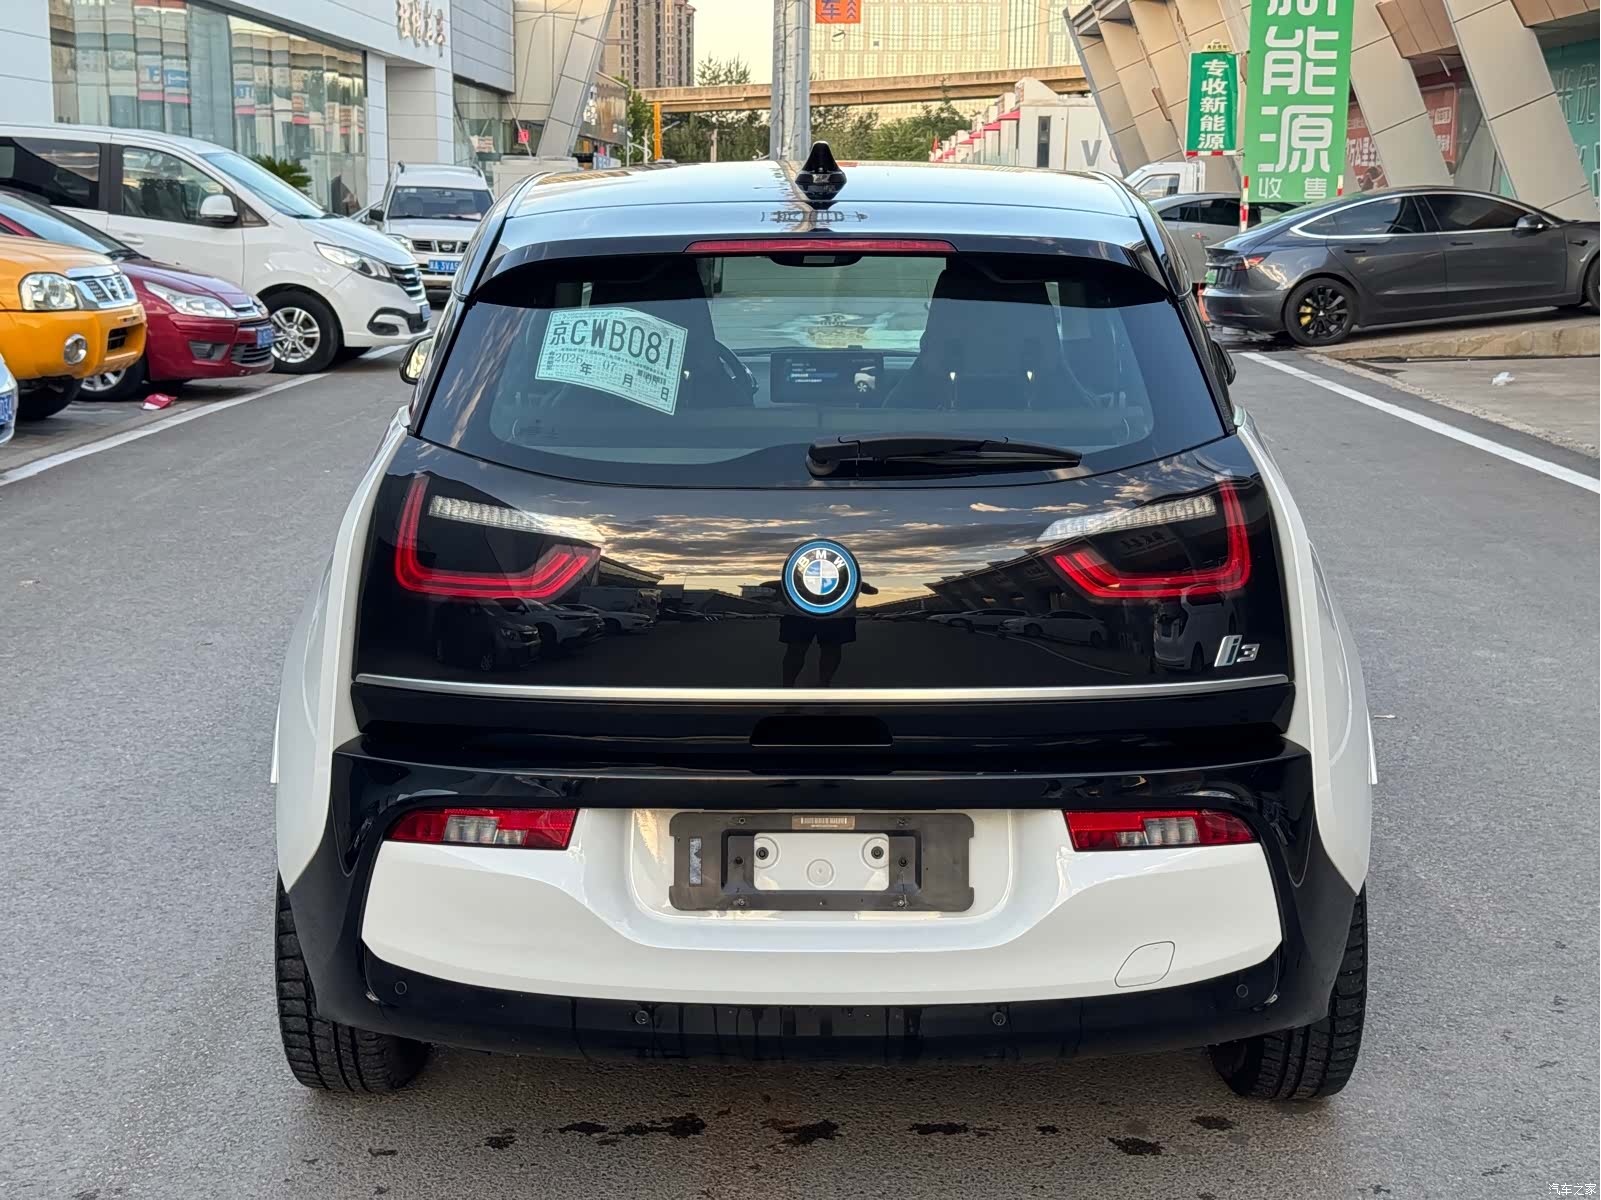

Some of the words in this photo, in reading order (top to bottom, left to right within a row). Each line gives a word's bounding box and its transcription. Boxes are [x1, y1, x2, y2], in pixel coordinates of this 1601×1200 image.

[1197, 59, 1229, 150] 专收新能源
[1257, 0, 1339, 173] 能源
[549, 318, 674, 370] 京CWB081
[797, 549, 846, 571] BMW
[1213, 634, 1260, 667] i3
